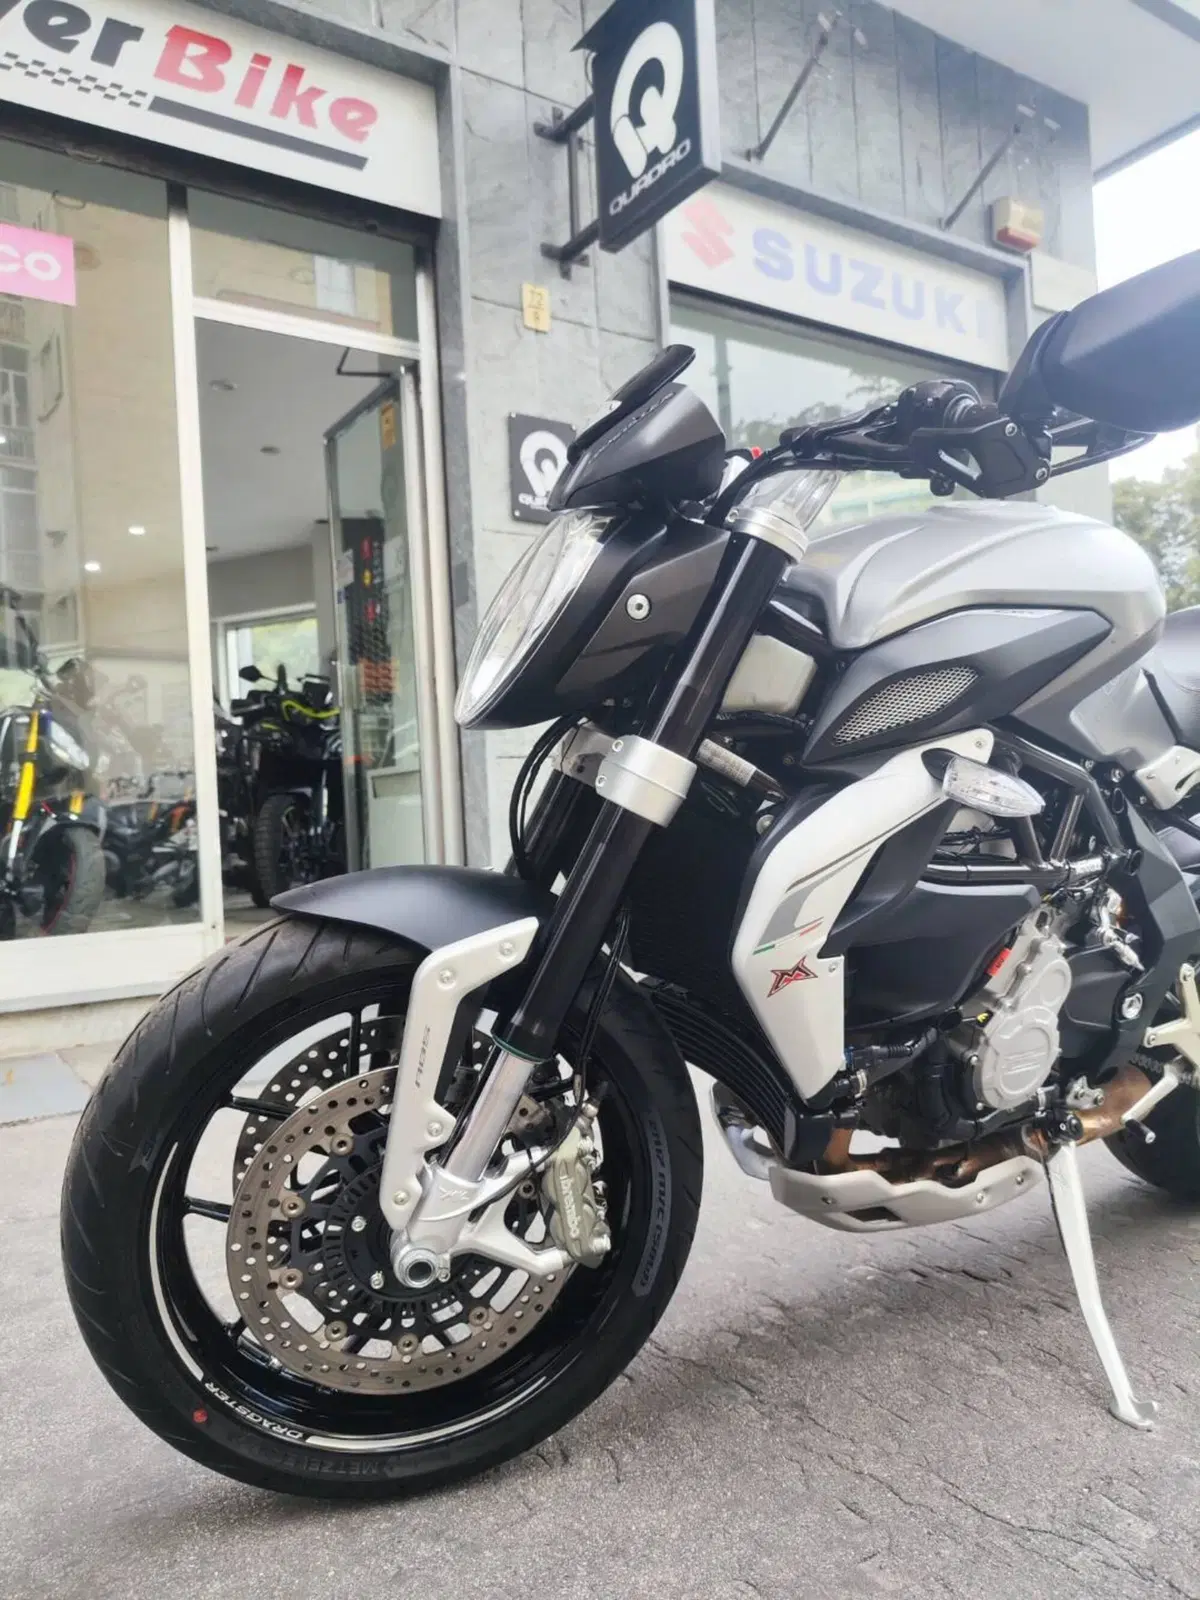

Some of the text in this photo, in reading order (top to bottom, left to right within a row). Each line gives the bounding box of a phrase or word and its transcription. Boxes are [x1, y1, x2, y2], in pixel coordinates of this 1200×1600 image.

[0, 0, 378, 143] er Bike
[609, 138, 691, 216] QUADRO
[752, 231, 989, 339] SUZUKI
[205, 1382, 304, 1439] DRAGSTER
